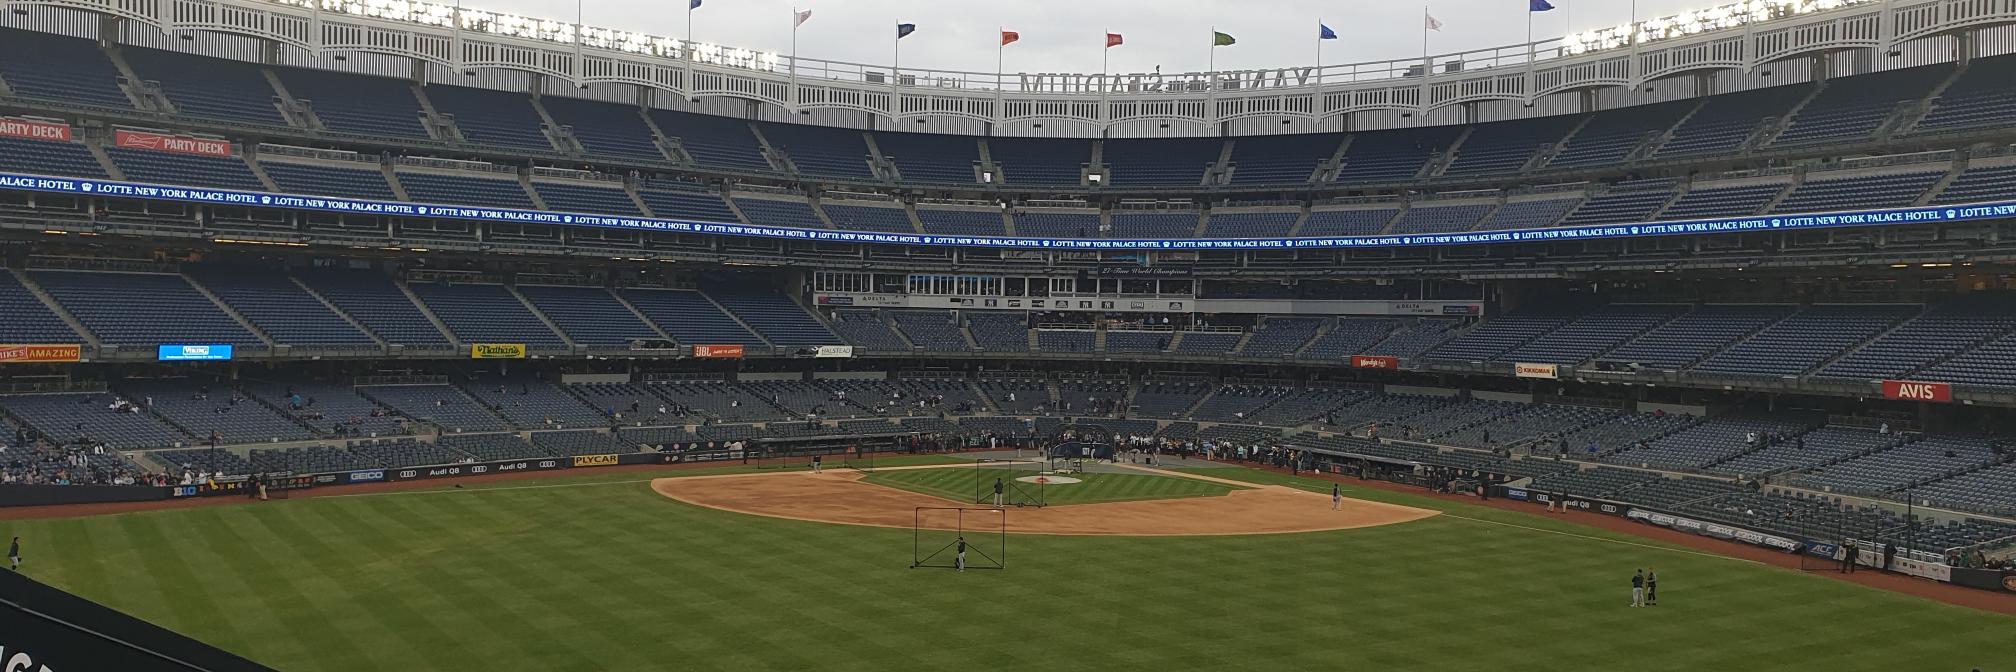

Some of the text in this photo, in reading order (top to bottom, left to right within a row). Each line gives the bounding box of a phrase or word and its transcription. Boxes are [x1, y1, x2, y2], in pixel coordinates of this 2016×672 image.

[0, 122, 63, 138] ARTY DECK
[164, 139, 195, 152] PARTY
[198, 142, 224, 154] DECK
[0, 177, 75, 190] ALACE HOTEL
[97, 184, 257, 202] LOTTE NEW YORK PALACE HOTEL
[274, 197, 303, 206] LOTTE
[327, 201, 349, 209] YORK
[351, 203, 382, 211] PALACE
[384, 205, 413, 213] HOTEL
[1960, 205, 2016, 217] LOTTE NEW
[504, 212, 532, 220] PALACE
[1784, 218, 1814, 226] LOTTE
[1838, 215, 1864, 223] YORK
[1867, 213, 1902, 222] PALACE
[1905, 211, 1940, 220] HOTEL
[1709, 222, 1737, 230] PALACE
[1739, 220, 1768, 228] HOTEL
[1154, 267, 1187, 276] Champions
[30, 349, 77, 357] AMAZING
[696, 346, 711, 357] JBL
[1899, 384, 1934, 400] AVIS
[575, 455, 618, 464] PLYCAR
[351, 472, 383, 480] GEICO
